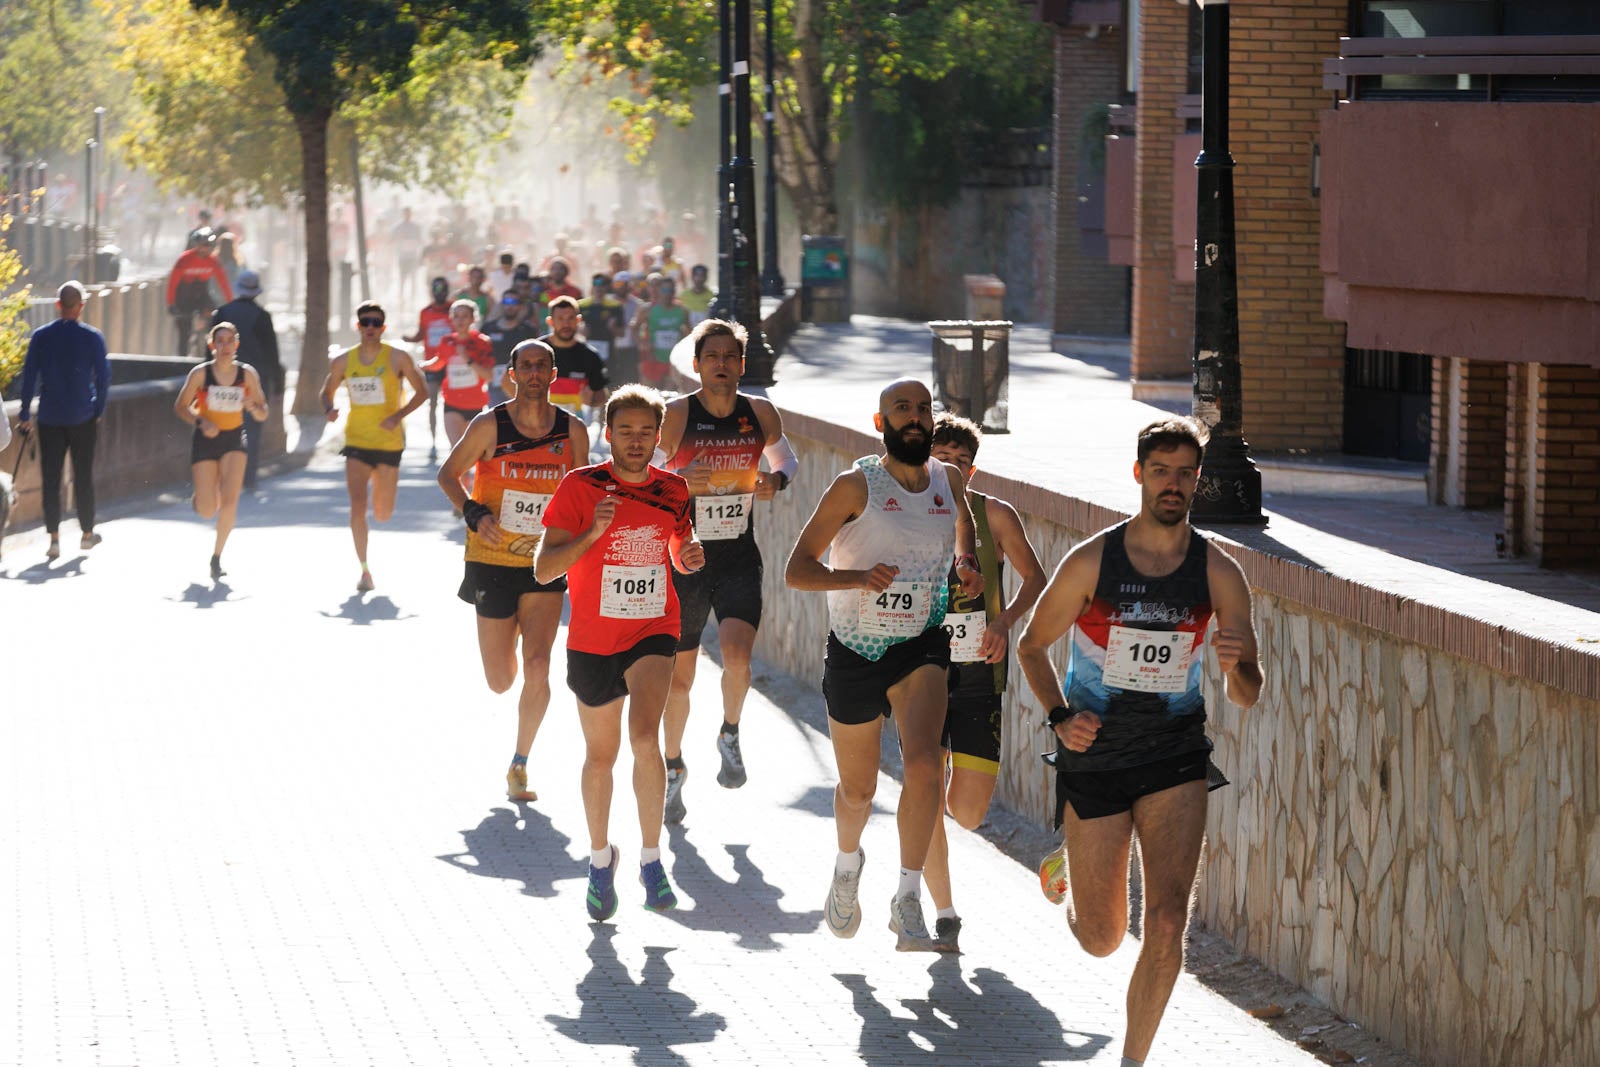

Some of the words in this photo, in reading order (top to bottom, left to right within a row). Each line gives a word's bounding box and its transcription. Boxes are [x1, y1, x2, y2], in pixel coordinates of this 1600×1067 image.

[694, 437, 757, 448] HAMMAM
[508, 461, 524, 469] Club
[525, 462, 560, 471] Deportivo
[515, 501, 542, 516] 941
[705, 503, 744, 519] 1122
[611, 540, 664, 552] carrera
[613, 578, 655, 595] 1081
[875, 592, 913, 610] 479
[1129, 643, 1171, 664] 109
[1139, 666, 1160, 674] BRUNO
